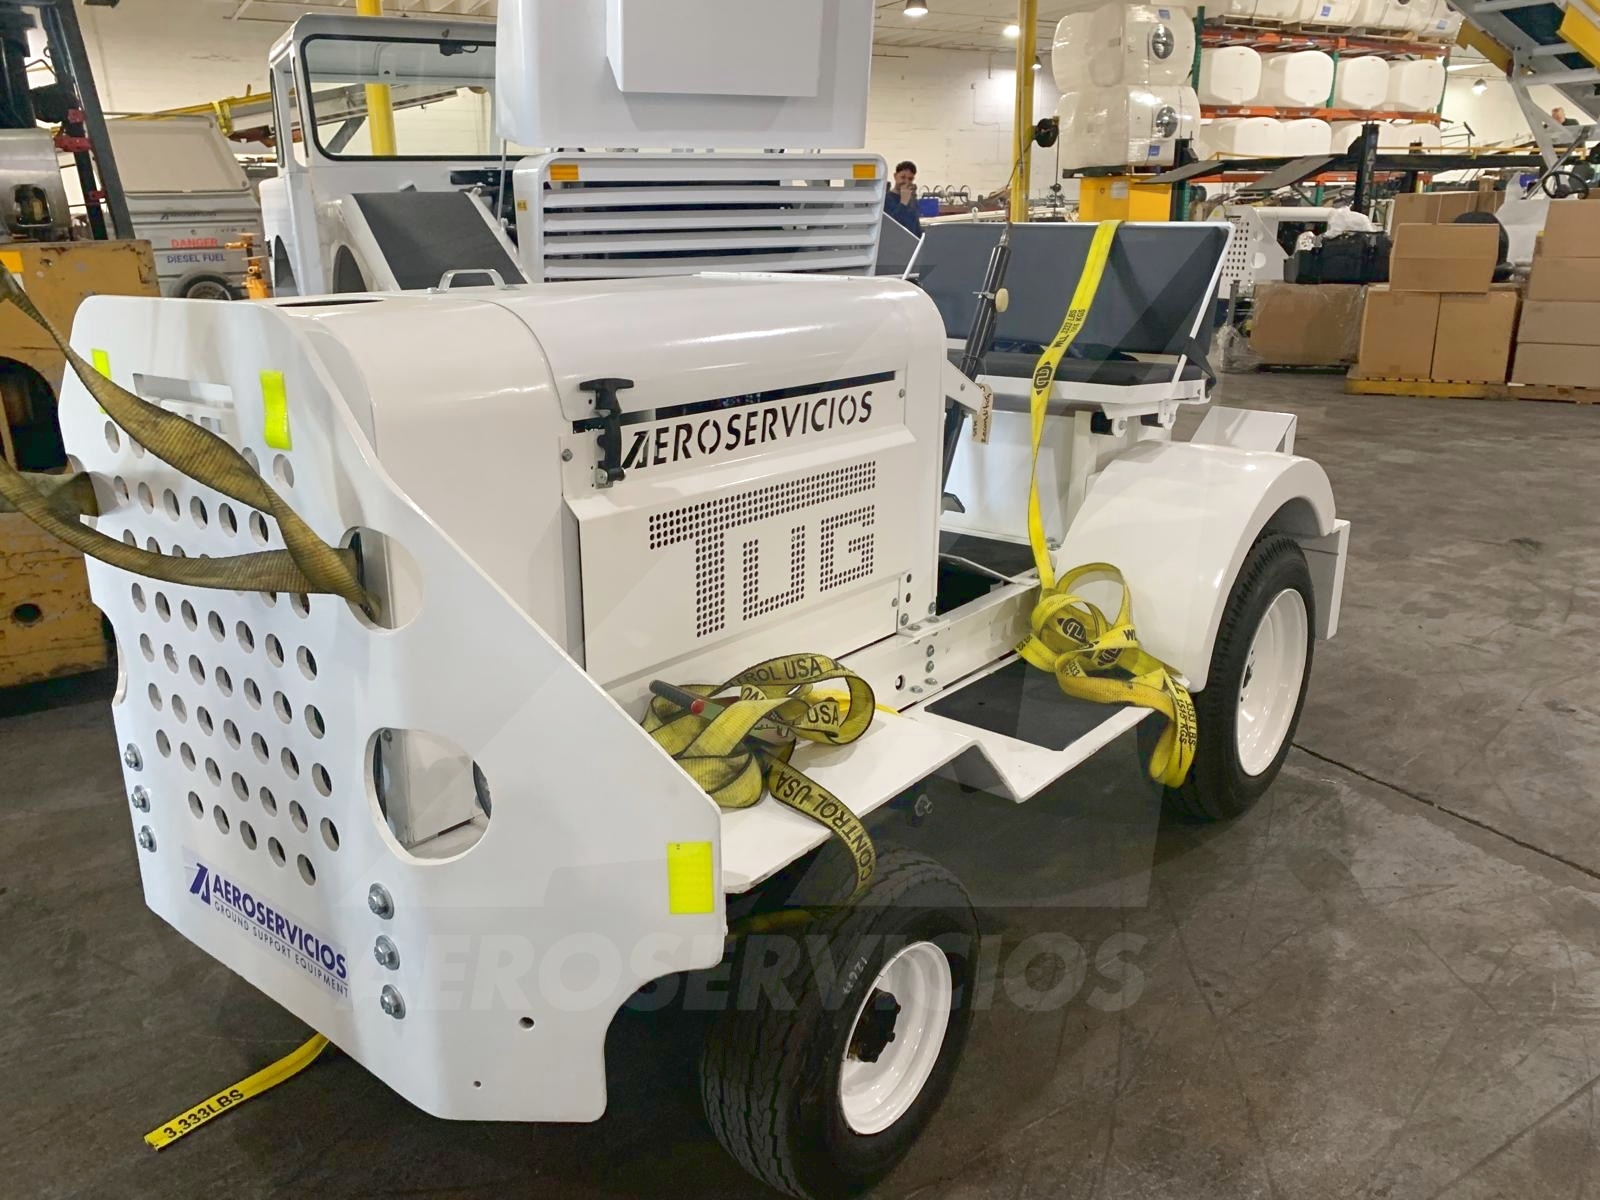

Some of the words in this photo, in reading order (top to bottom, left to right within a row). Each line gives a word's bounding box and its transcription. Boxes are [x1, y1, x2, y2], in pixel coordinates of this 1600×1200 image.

[167, 254, 200, 264] DIESEL
[203, 252, 226, 262] FUEL
[170, 236, 218, 250] DANGER
[622, 390, 873, 470] AEROSERVICIOS
[648, 460, 876, 638] TUG
[783, 656, 824, 680] USA
[806, 703, 840, 726] USA
[1187, 725, 1197, 747] LBS
[775, 771, 813, 804] USA
[813, 793, 873, 882] CONTROL
[213, 874, 348, 979] AEROSERVICIOS
[214, 901, 249, 931] GROUND
[252, 926, 292, 958] SUPPORT
[295, 954, 349, 998] EQUIPMENT
[163, 1089, 244, 1138] 3,333LBS
